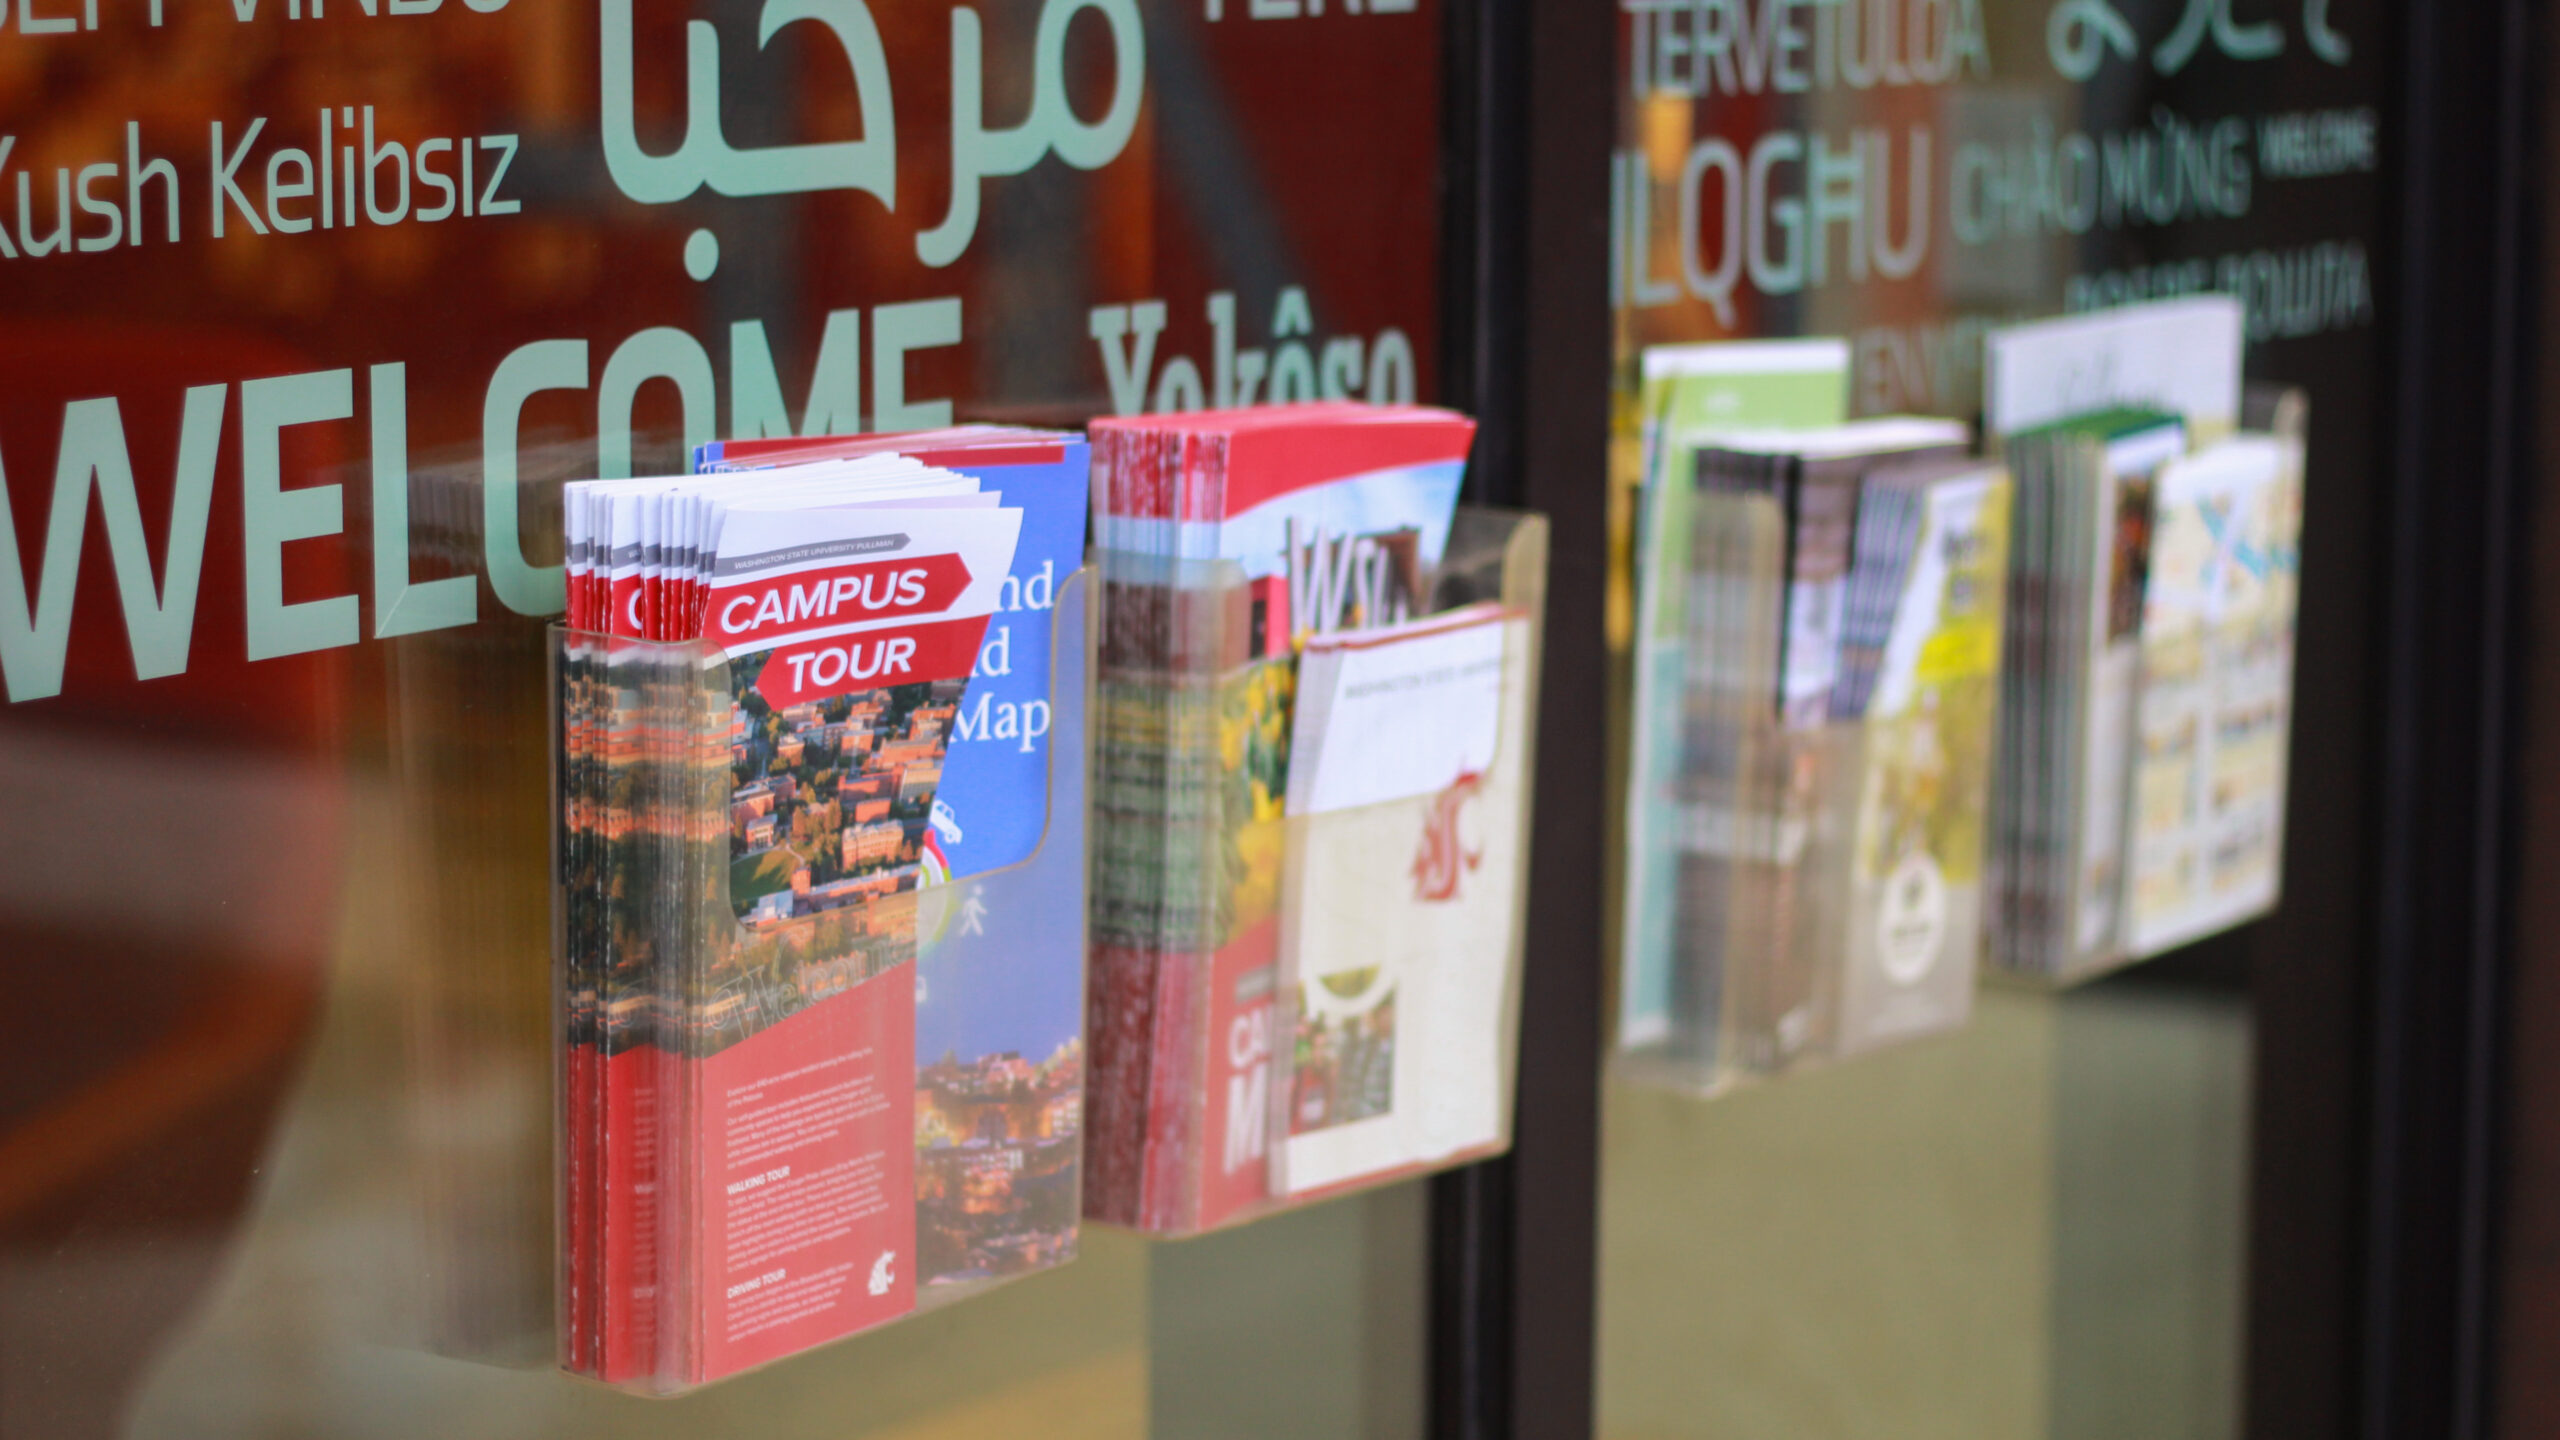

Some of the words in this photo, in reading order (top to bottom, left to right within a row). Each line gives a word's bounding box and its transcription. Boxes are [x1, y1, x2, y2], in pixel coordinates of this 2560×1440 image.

[734, 553, 786, 570] WASHINGTON
[786, 548, 808, 561] STATE
[809, 542, 855, 557] UNIVERSITY
[721, 569, 928, 635] CAMPUS
[786, 637, 916, 692] TOUR
[949, 691, 1051, 753] Map
[727, 1172, 766, 1195] WALKING
[766, 1166, 790, 1184] TOUR
[727, 1276, 761, 1299] DRIVING
[762, 1268, 787, 1286] TOUR
